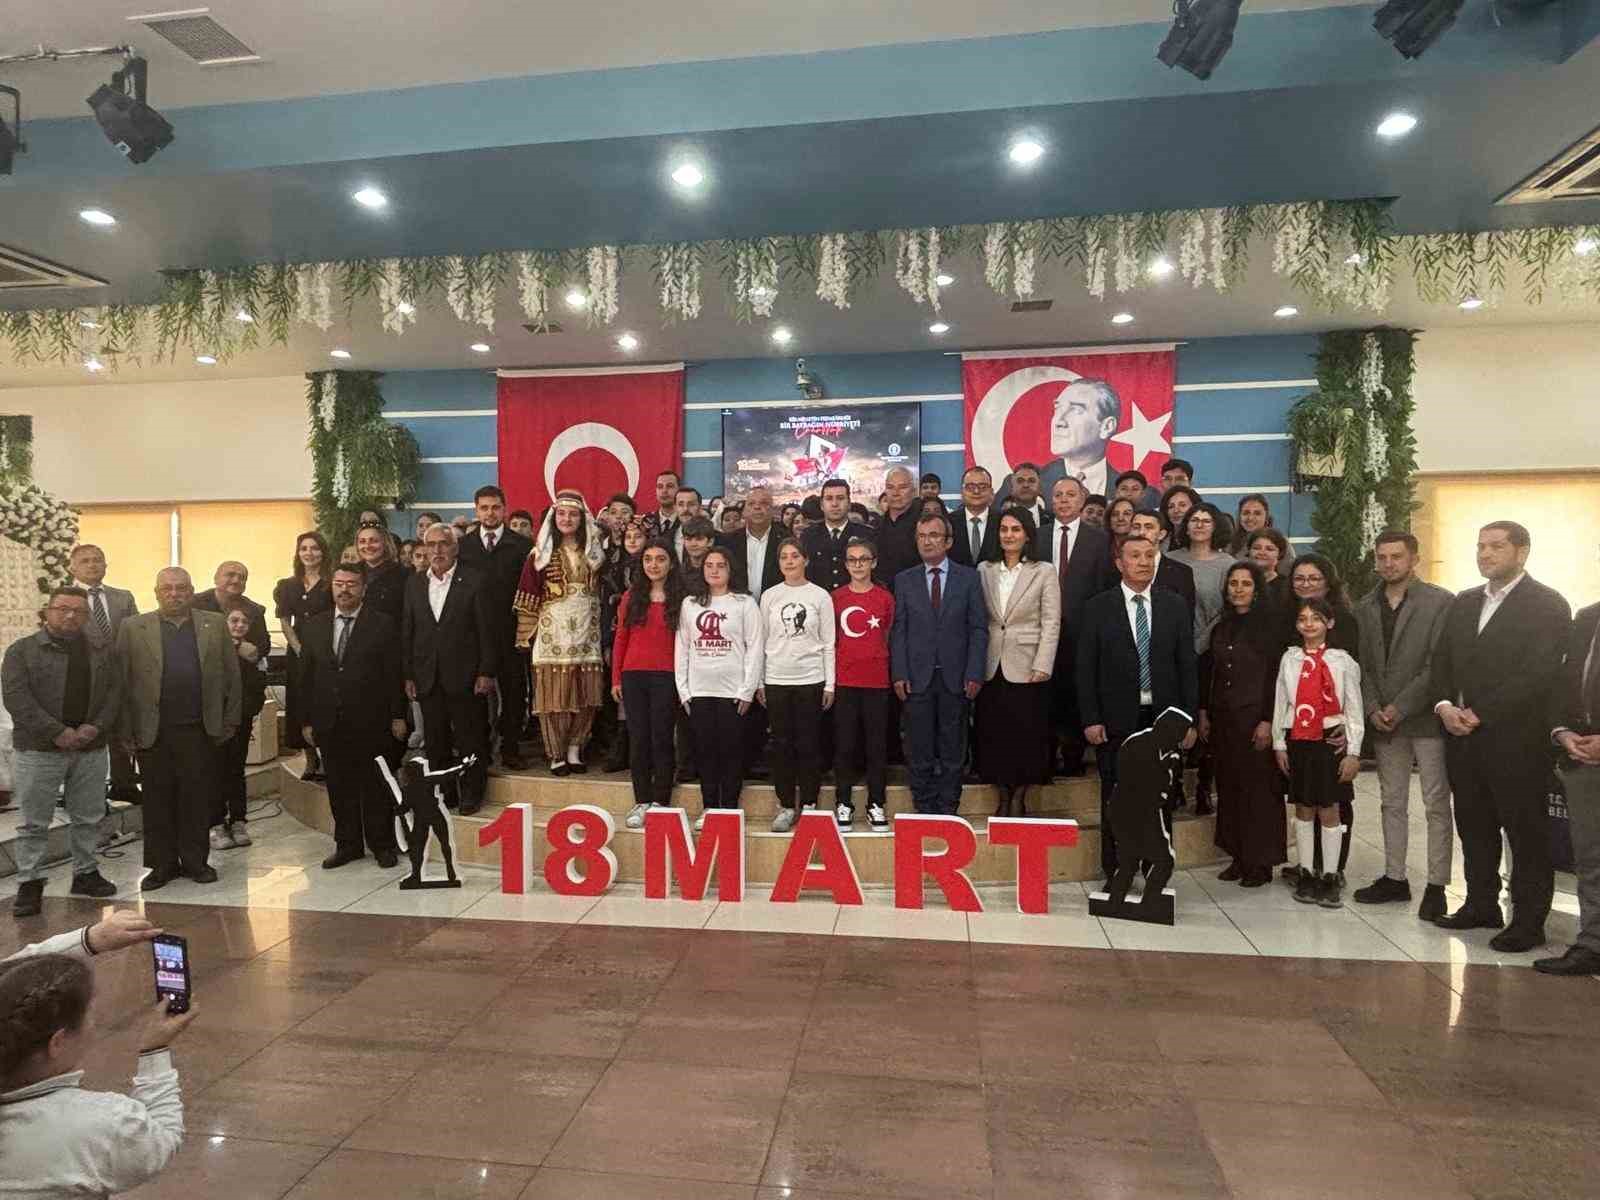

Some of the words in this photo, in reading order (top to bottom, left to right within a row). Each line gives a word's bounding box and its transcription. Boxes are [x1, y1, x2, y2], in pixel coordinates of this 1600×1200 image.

[705, 640, 732, 648] MART
[478, 803, 618, 897] 18
[644, 808, 1080, 914] MART
